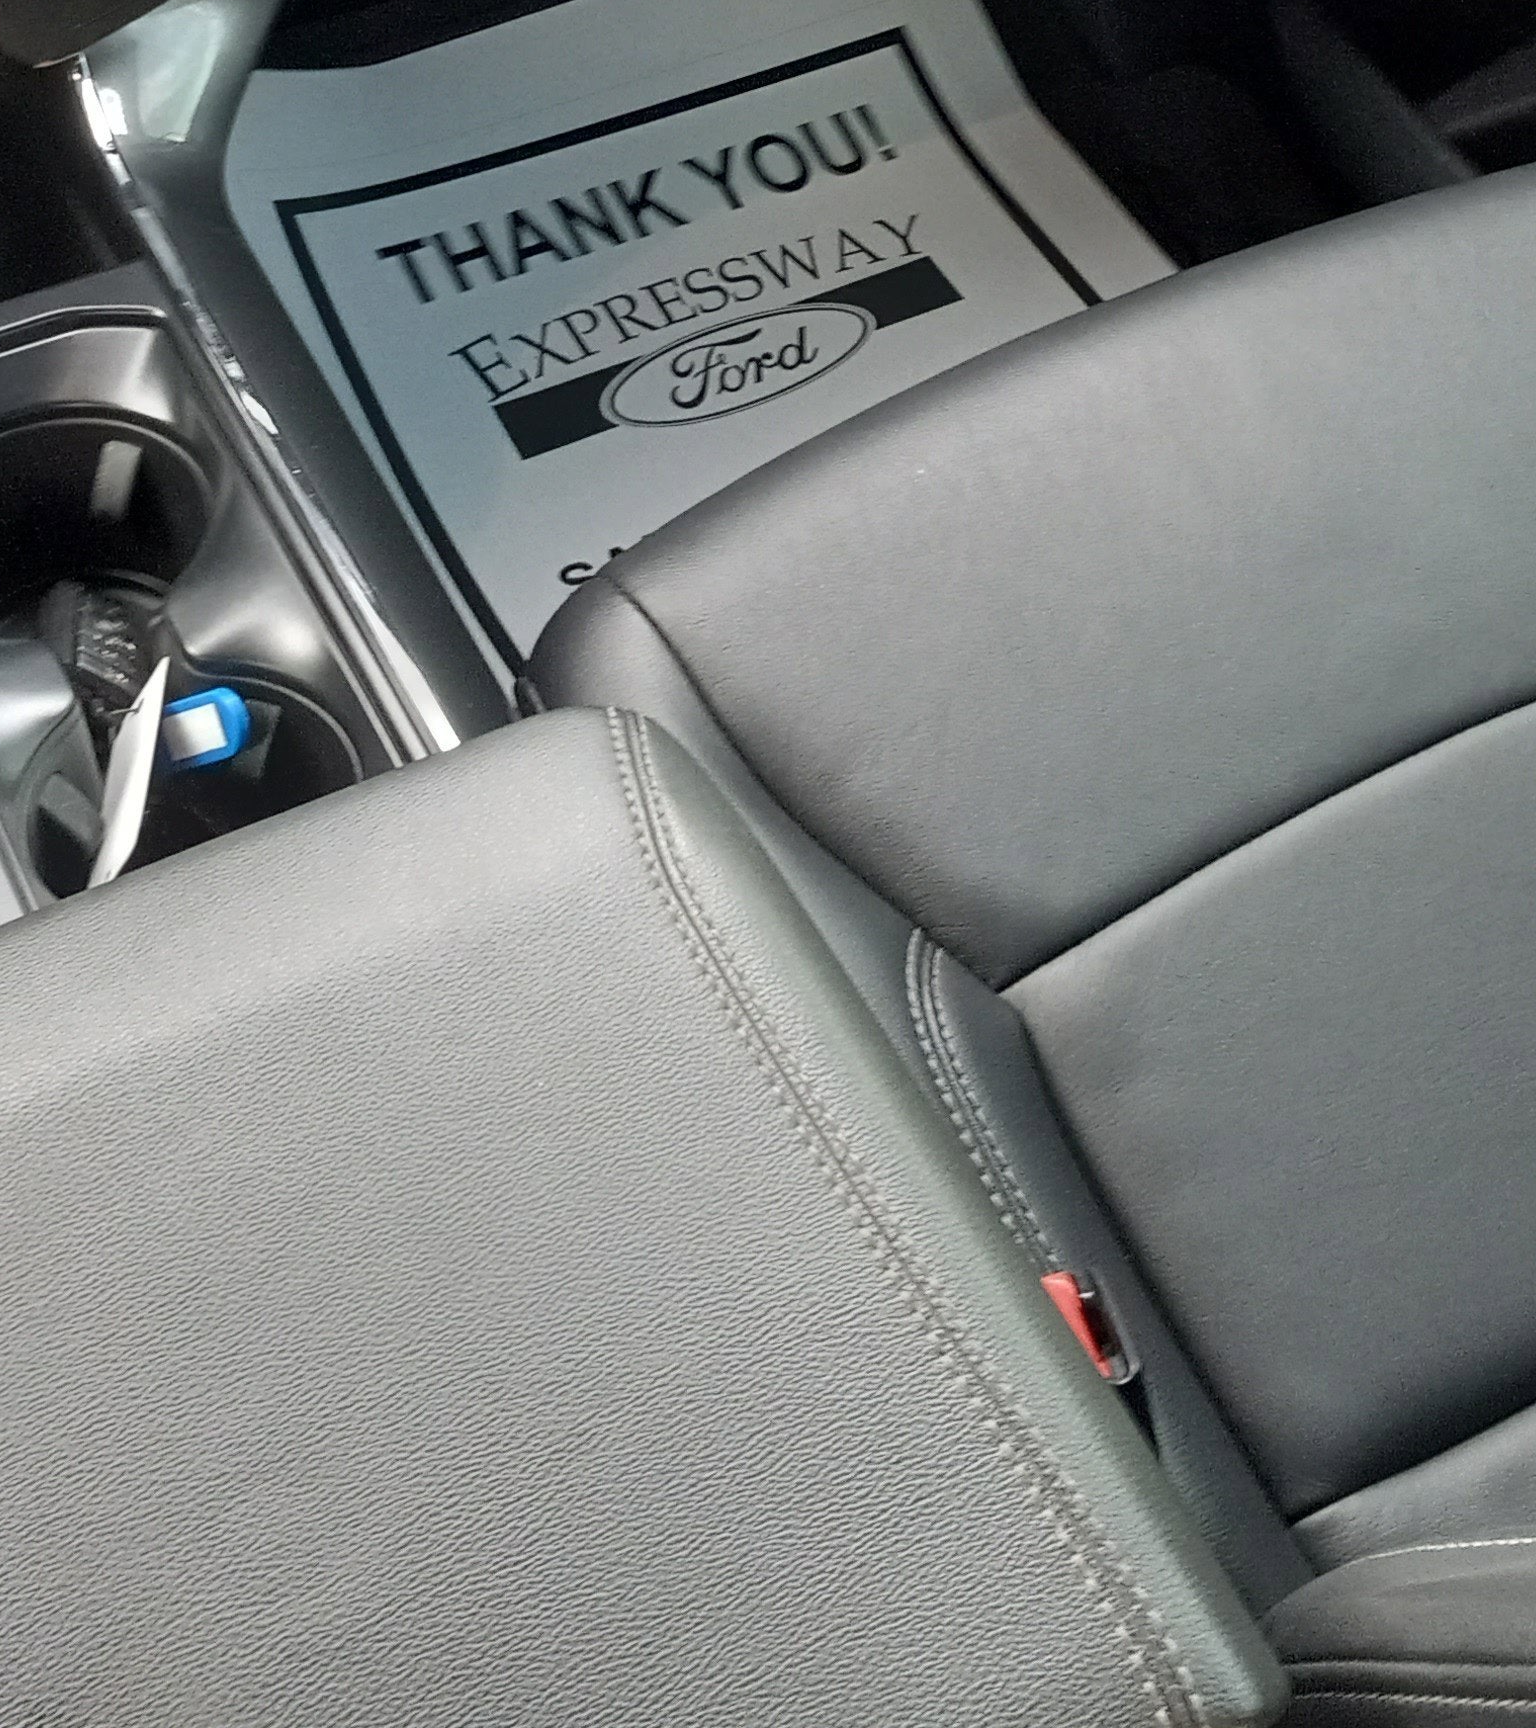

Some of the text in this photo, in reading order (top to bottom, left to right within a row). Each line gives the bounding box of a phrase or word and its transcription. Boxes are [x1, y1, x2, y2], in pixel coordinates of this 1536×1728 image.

[375, 105, 900, 304] THANK YOU!
[448, 212, 922, 403] EXPRESSWAY
[667, 325, 821, 410] Ford
